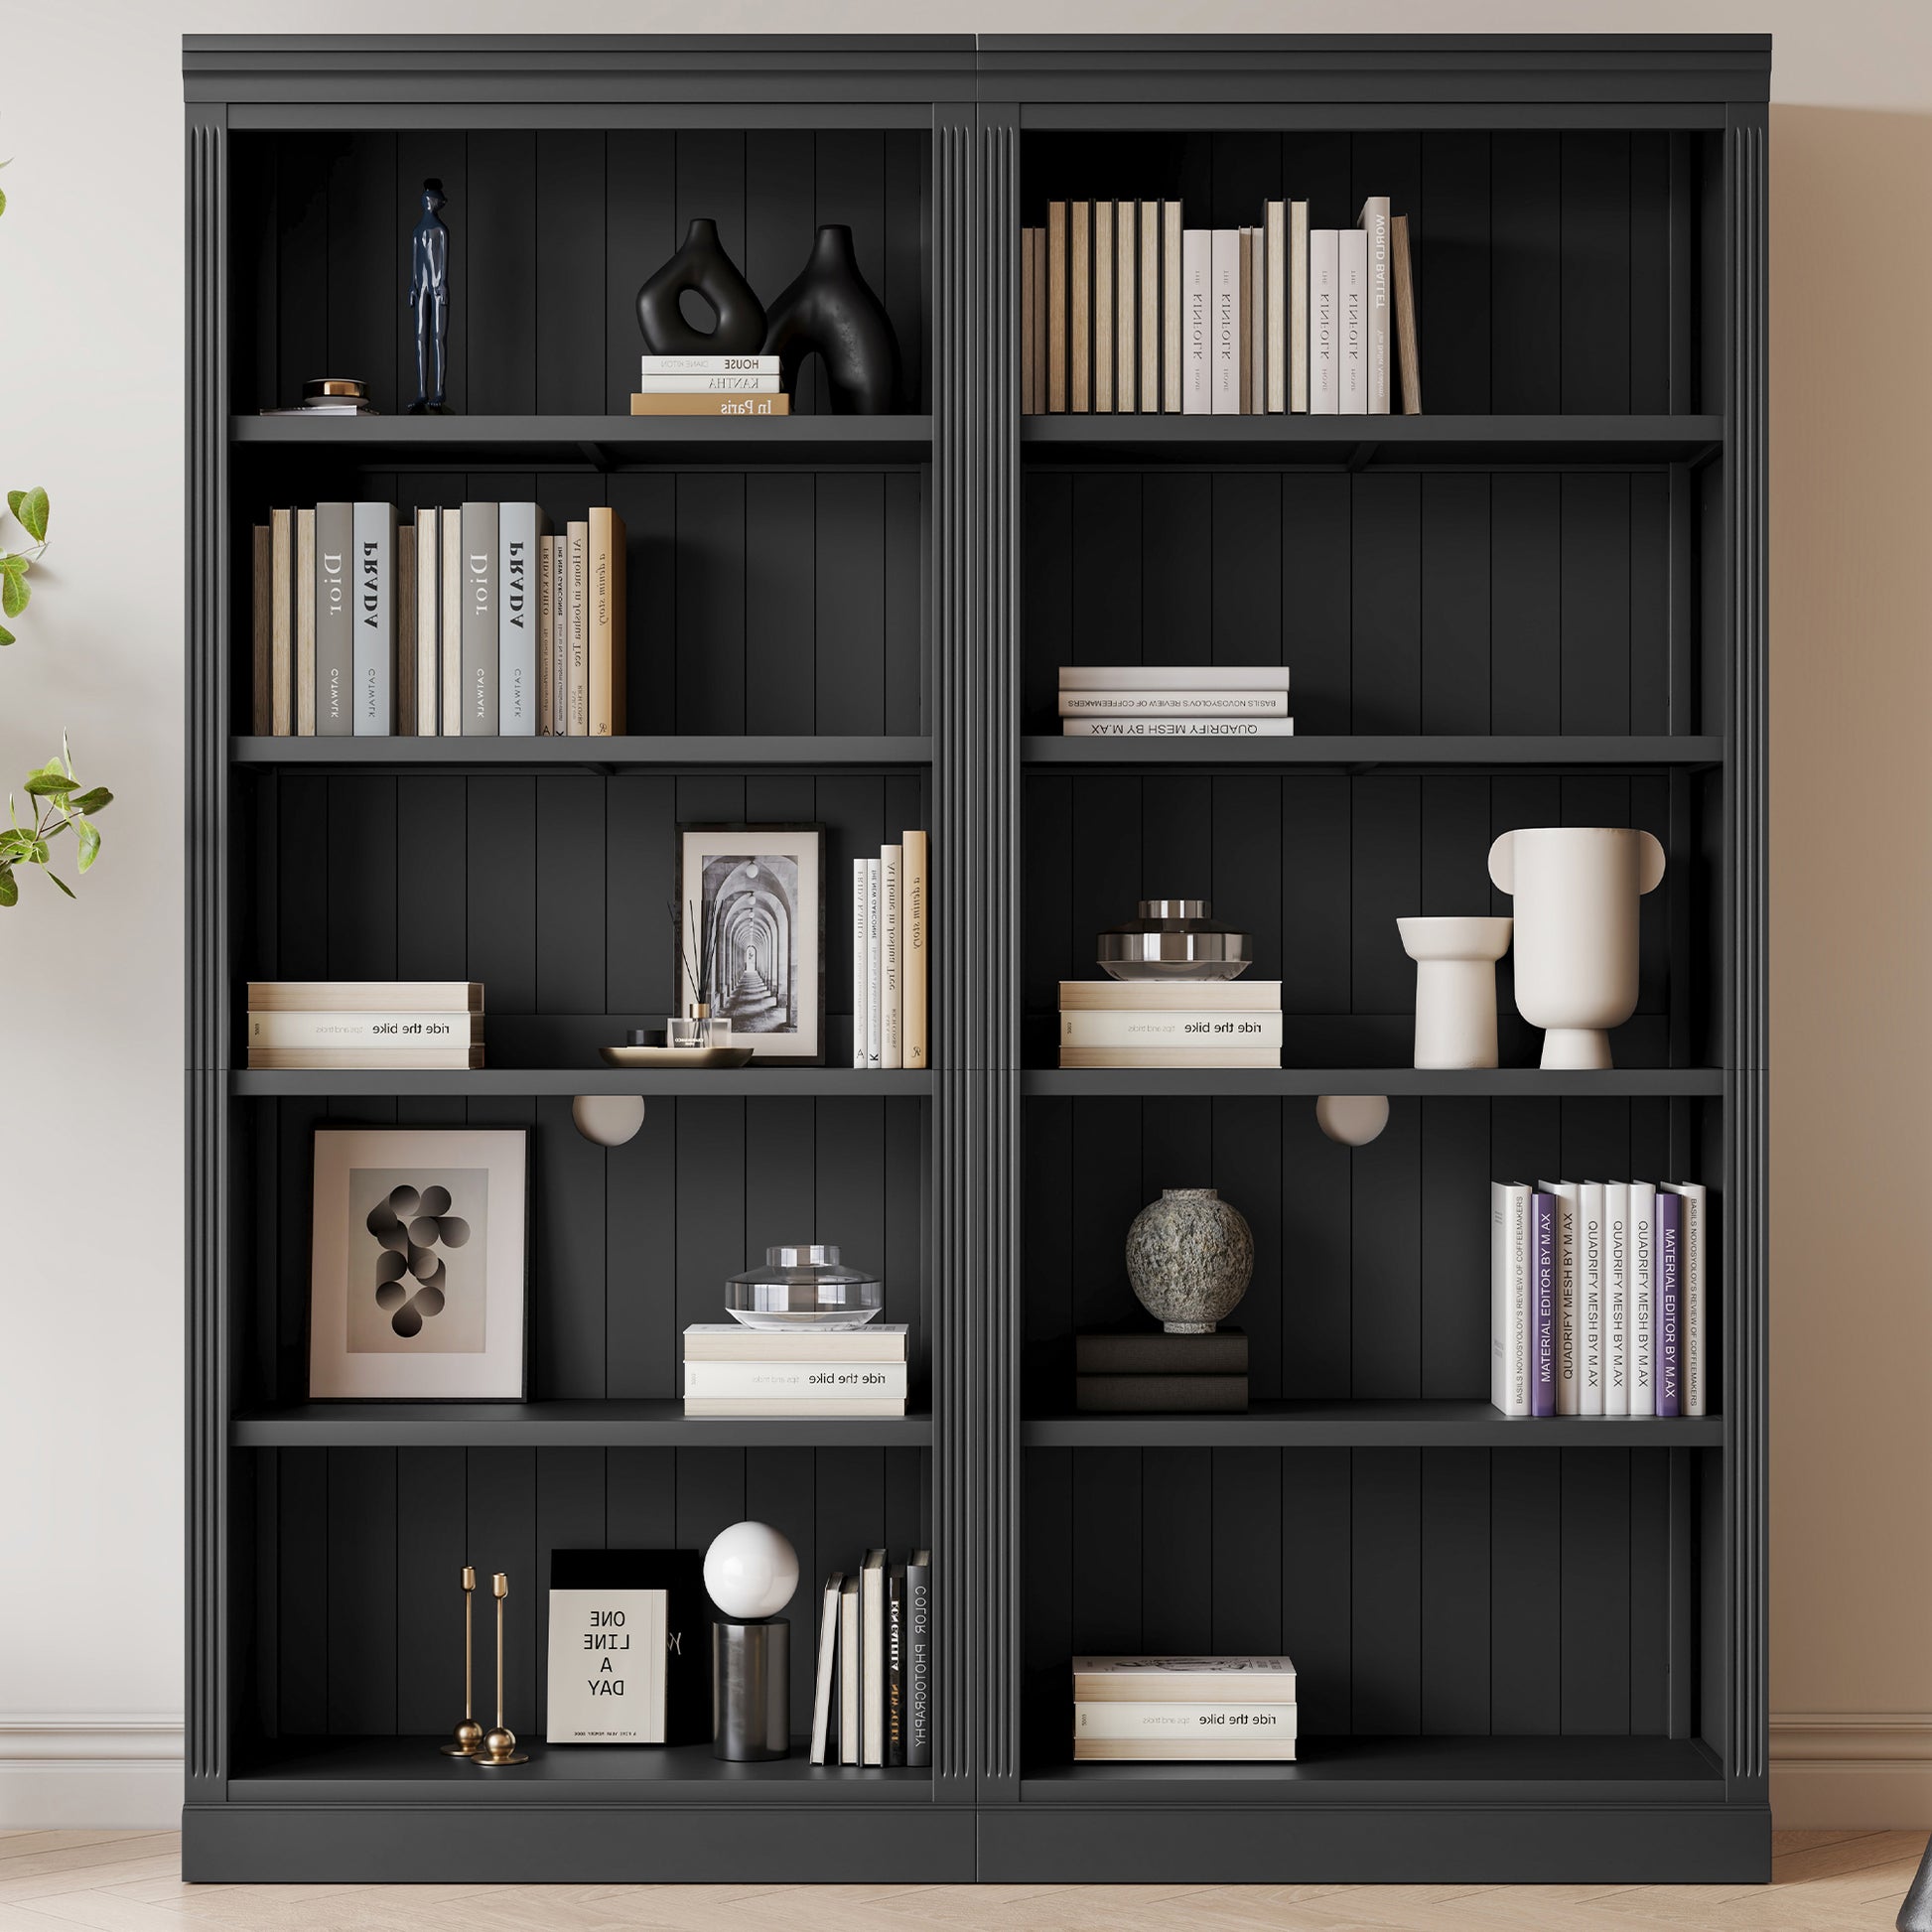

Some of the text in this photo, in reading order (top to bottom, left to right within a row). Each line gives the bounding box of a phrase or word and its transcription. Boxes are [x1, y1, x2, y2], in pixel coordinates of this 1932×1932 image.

[1091, 724, 1258, 734] QUADRIFY MESH BY M.AX
[1516, 1264, 1523, 1275] OF
[1542, 1213, 1551, 1382] MATERIAL EDITOR BY M.AX
[1564, 1213, 1573, 1380] QUADRIFY MESH BY M.AX
[1588, 1221, 1597, 1387] QUADRIFY MESH BY M.AX
[1613, 1221, 1623, 1387] QUADRIFY MESH BY M.AX
[1638, 1221, 1648, 1387] QUADRIFY MESH BY M.AX
[1665, 1229, 1675, 1398] MATERIAL EDITOR BY M.AX
[1691, 1327, 1697, 1338] OF
